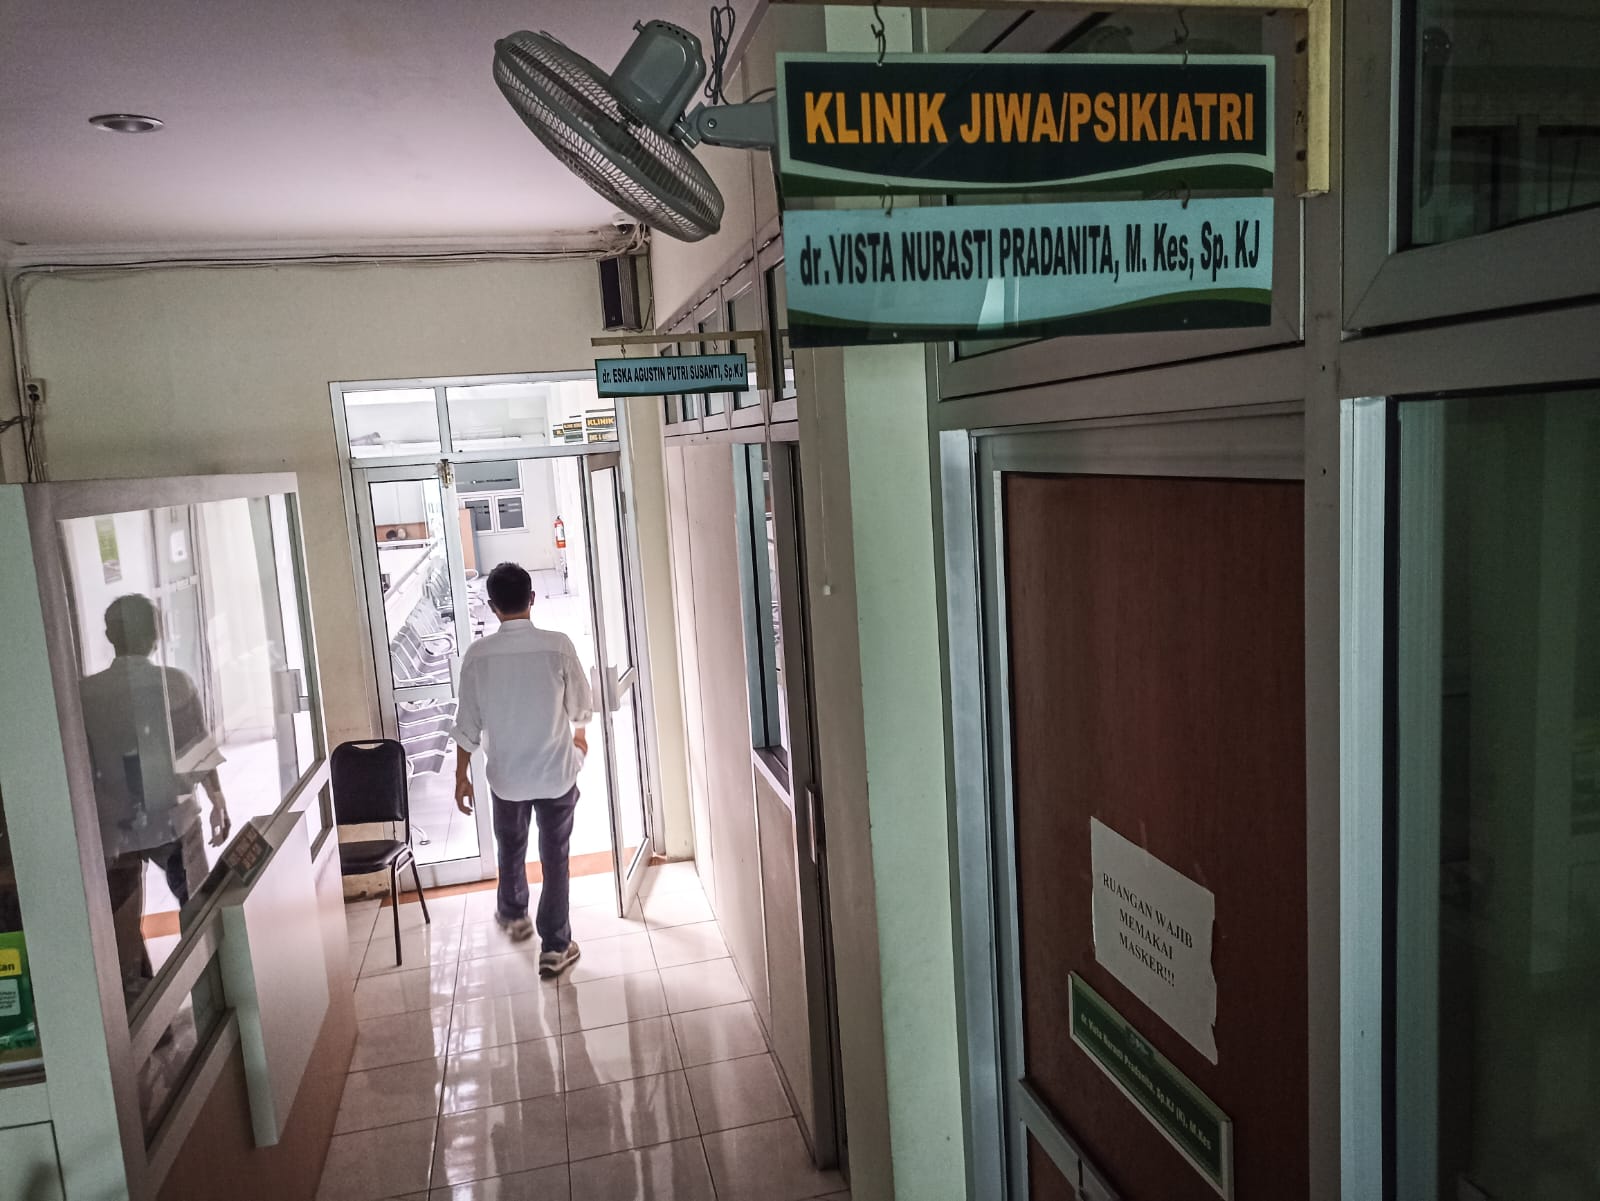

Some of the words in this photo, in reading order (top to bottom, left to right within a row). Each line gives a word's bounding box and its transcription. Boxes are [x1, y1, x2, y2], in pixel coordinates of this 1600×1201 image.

[804, 91, 949, 144] KLINIK
[960, 92, 1255, 144] JIWA/PSIKIATRI
[901, 229, 993, 282] NURASTI
[1000, 224, 1121, 284] PRADANITA,
[602, 368, 612, 384] dr.
[612, 367, 633, 384] ESKA
[634, 366, 666, 383] AGUSTIN
[667, 365, 689, 382] PUTRI
[690, 363, 723, 382] SUSANTI,
[587, 417, 614, 427] KLINIK
[1103, 872, 1153, 919] RUANGAN
[1155, 909, 1193, 949] WAJIB
[1119, 908, 1173, 961] MEMAKAI
[1119, 932, 1175, 988] MASKER!!!
